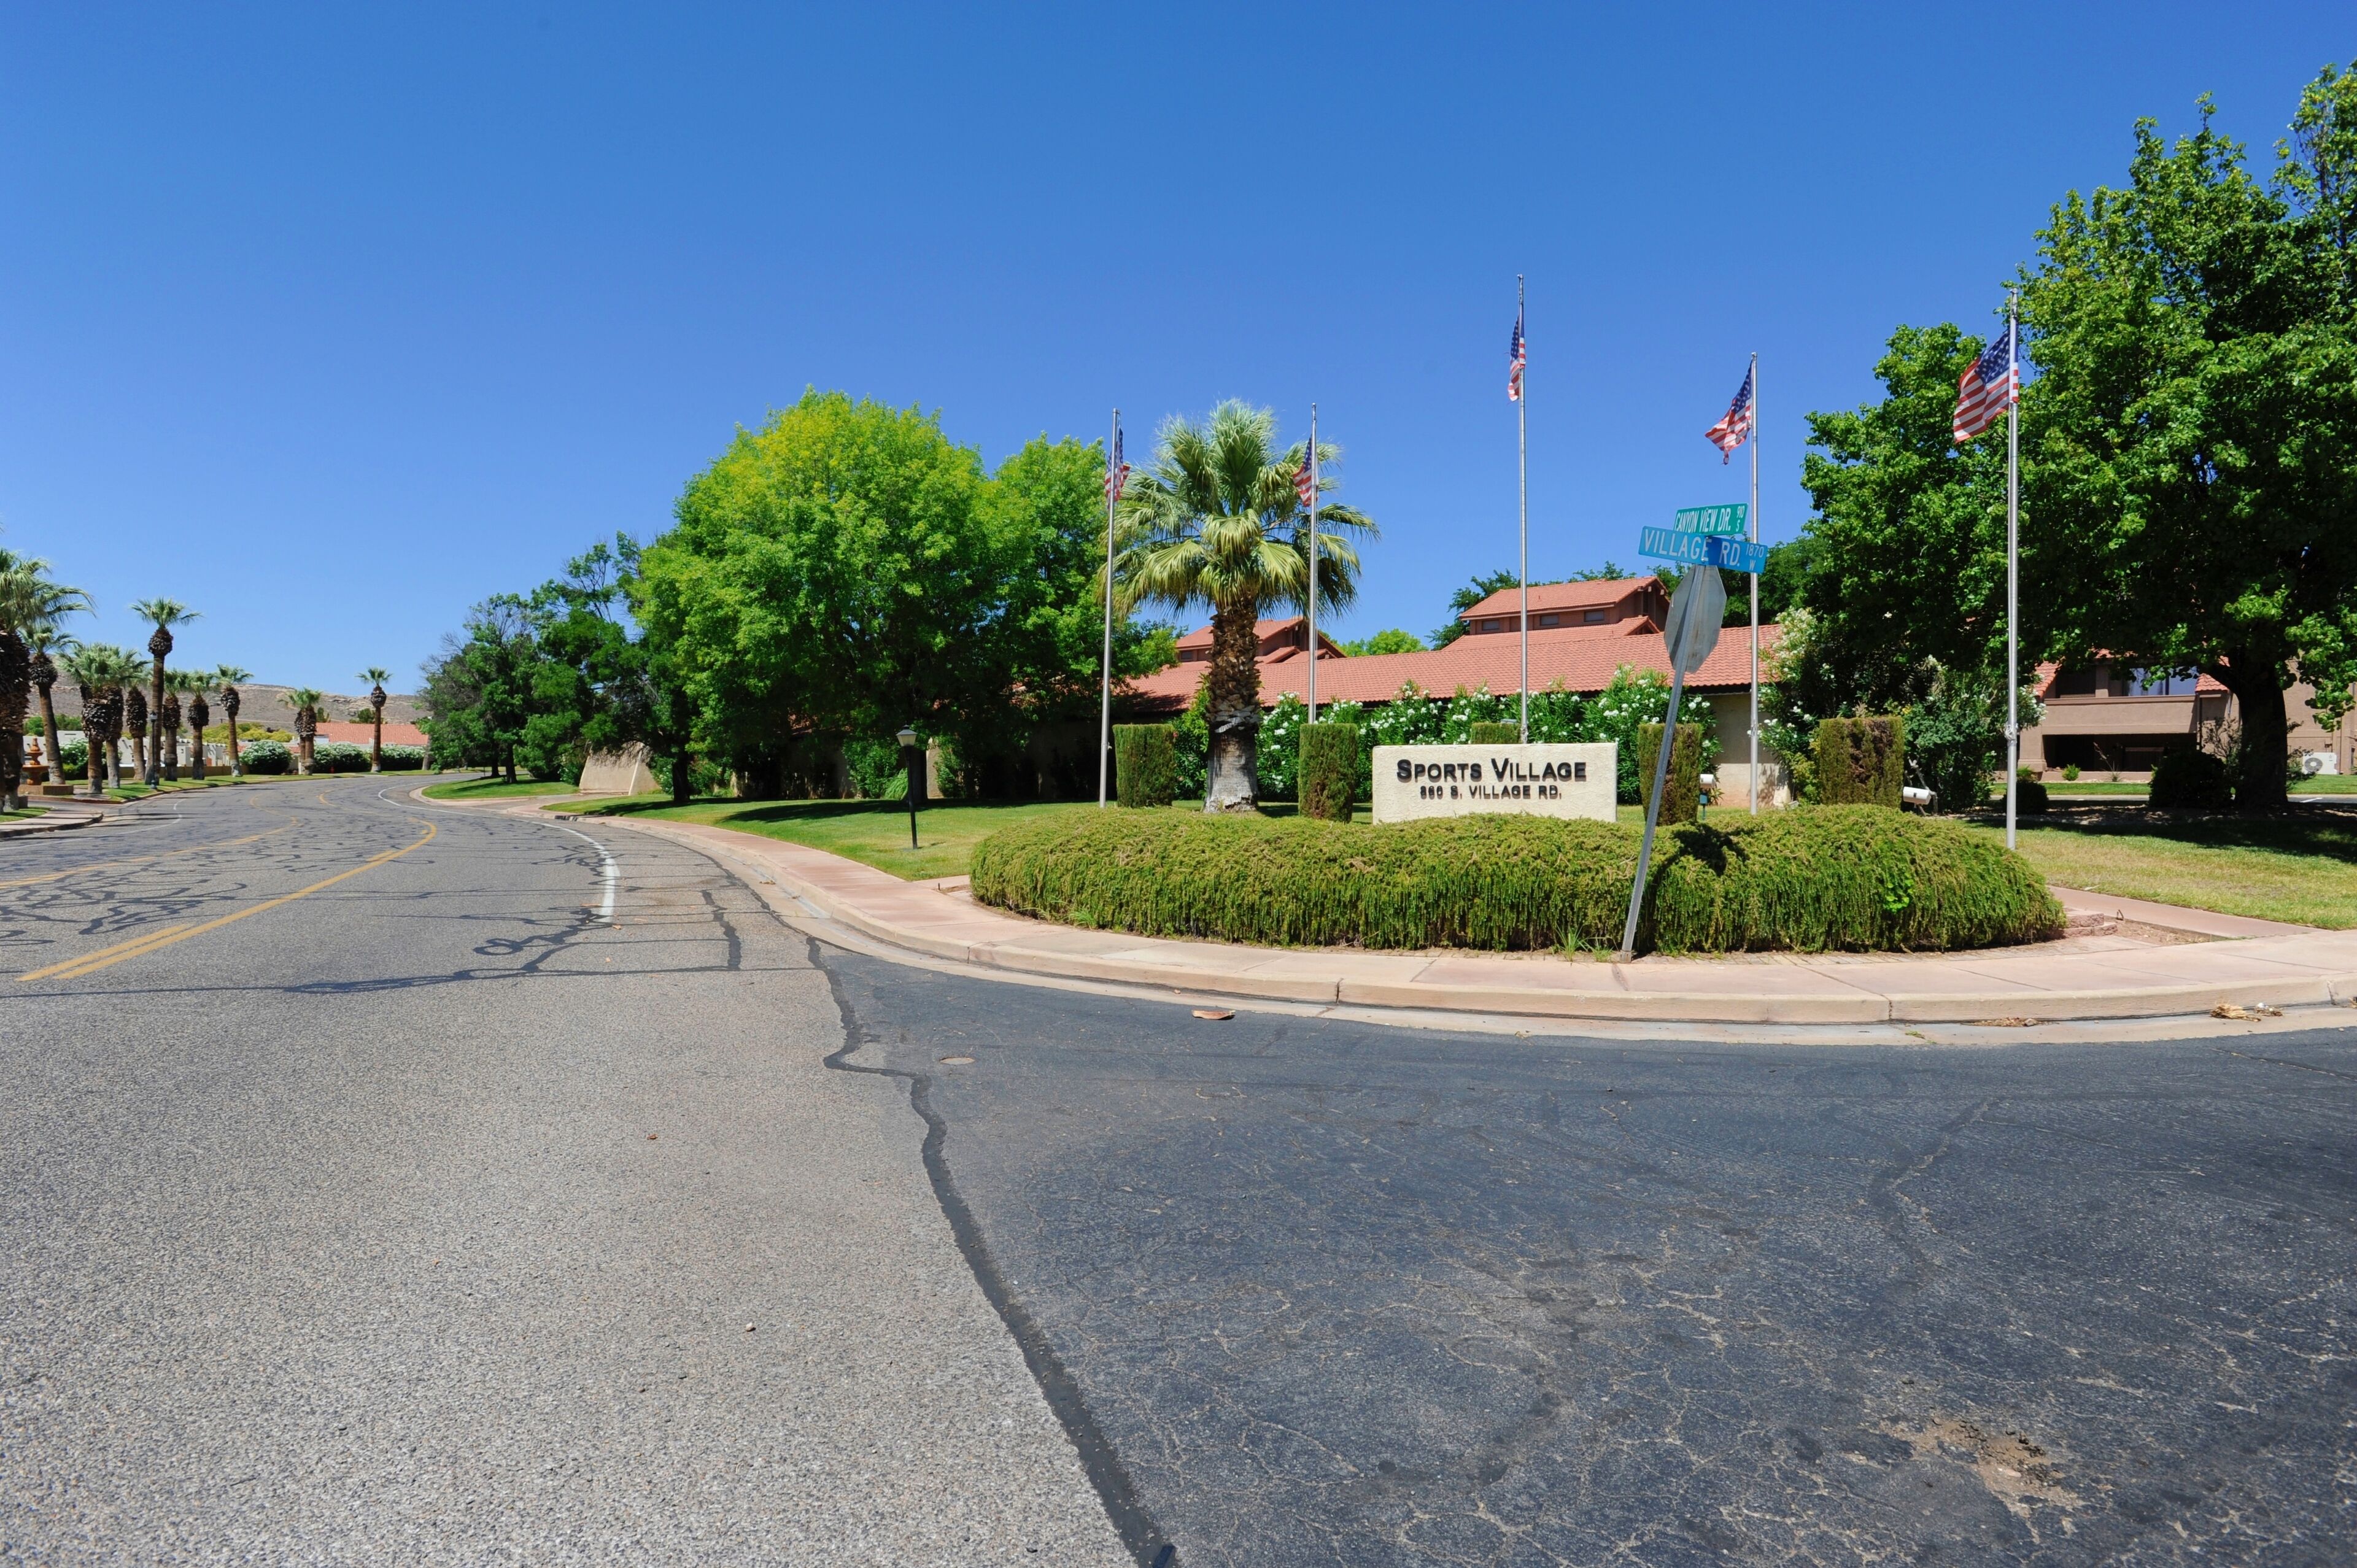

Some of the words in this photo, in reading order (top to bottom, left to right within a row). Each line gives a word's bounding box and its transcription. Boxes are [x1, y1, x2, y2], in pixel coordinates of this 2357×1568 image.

[1674, 511, 1699, 533] CANYON
[1700, 509, 1718, 531] VIEW
[1717, 508, 1731, 531] DR.
[1736, 519, 1741, 532] S
[1645, 528, 1712, 562] VILLAGE
[1719, 541, 1741, 567] RD.
[1746, 544, 1764, 558] 1870
[1749, 559, 1755, 571] W
[1450, 786, 1462, 798] S.
[1469, 785, 1530, 797] VILLAGE
[1539, 785, 1562, 798] RD.
